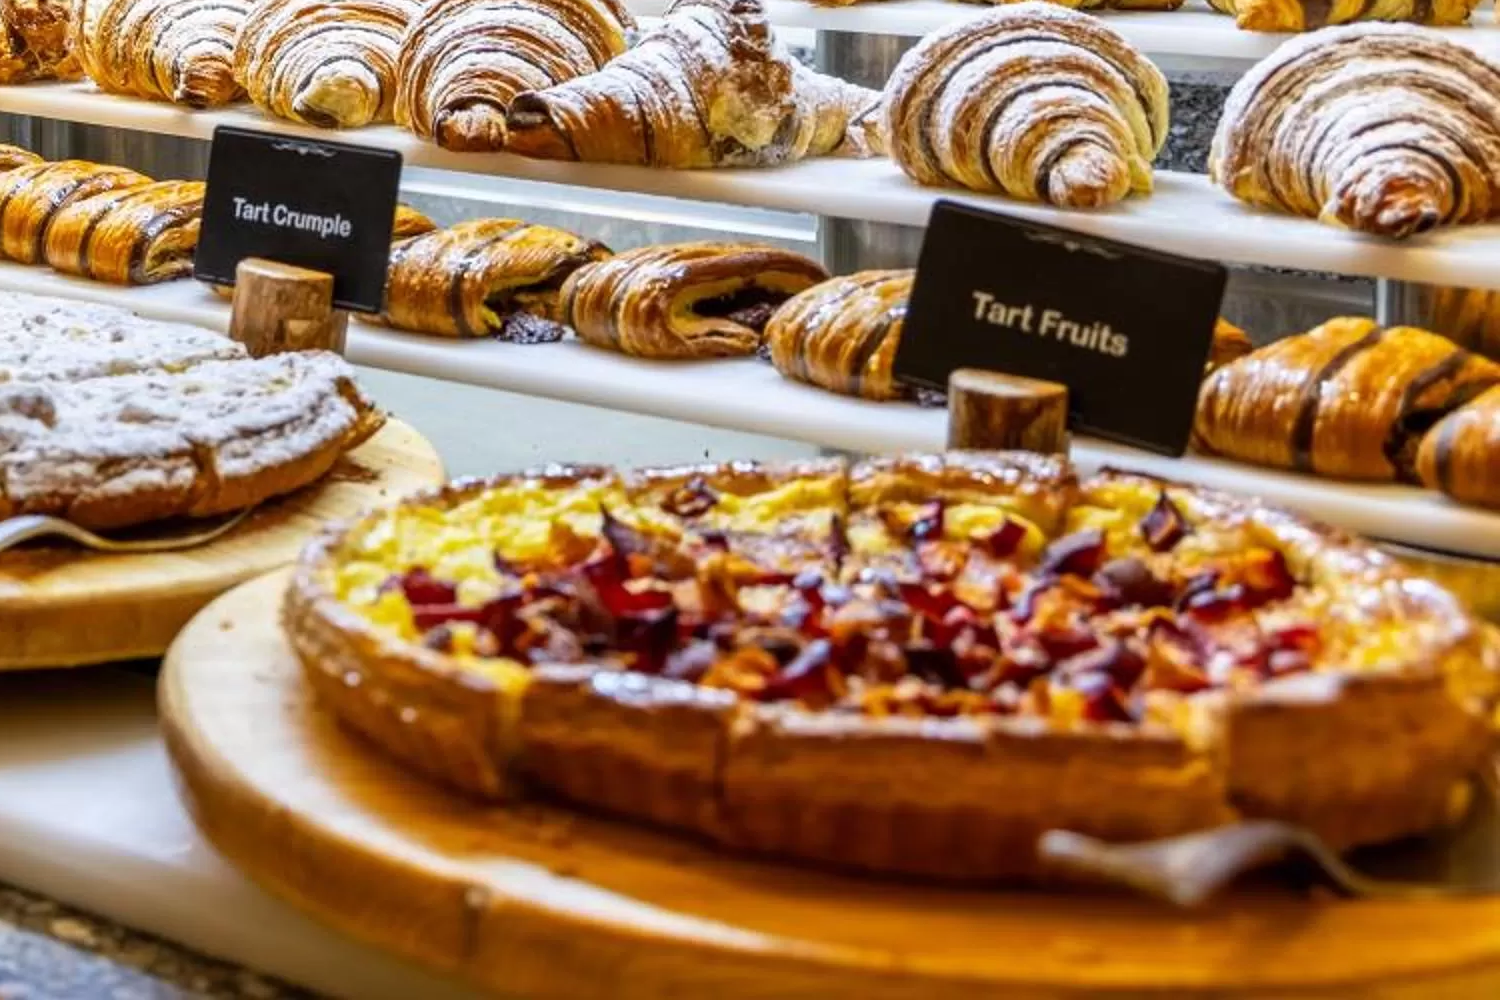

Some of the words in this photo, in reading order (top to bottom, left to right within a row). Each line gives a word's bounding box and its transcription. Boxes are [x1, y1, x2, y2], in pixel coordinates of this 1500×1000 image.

[233, 197, 269, 223] Tart
[273, 204, 351, 238] Crumple
[972, 290, 1033, 333] Tart
[1038, 309, 1129, 358] Fruits
